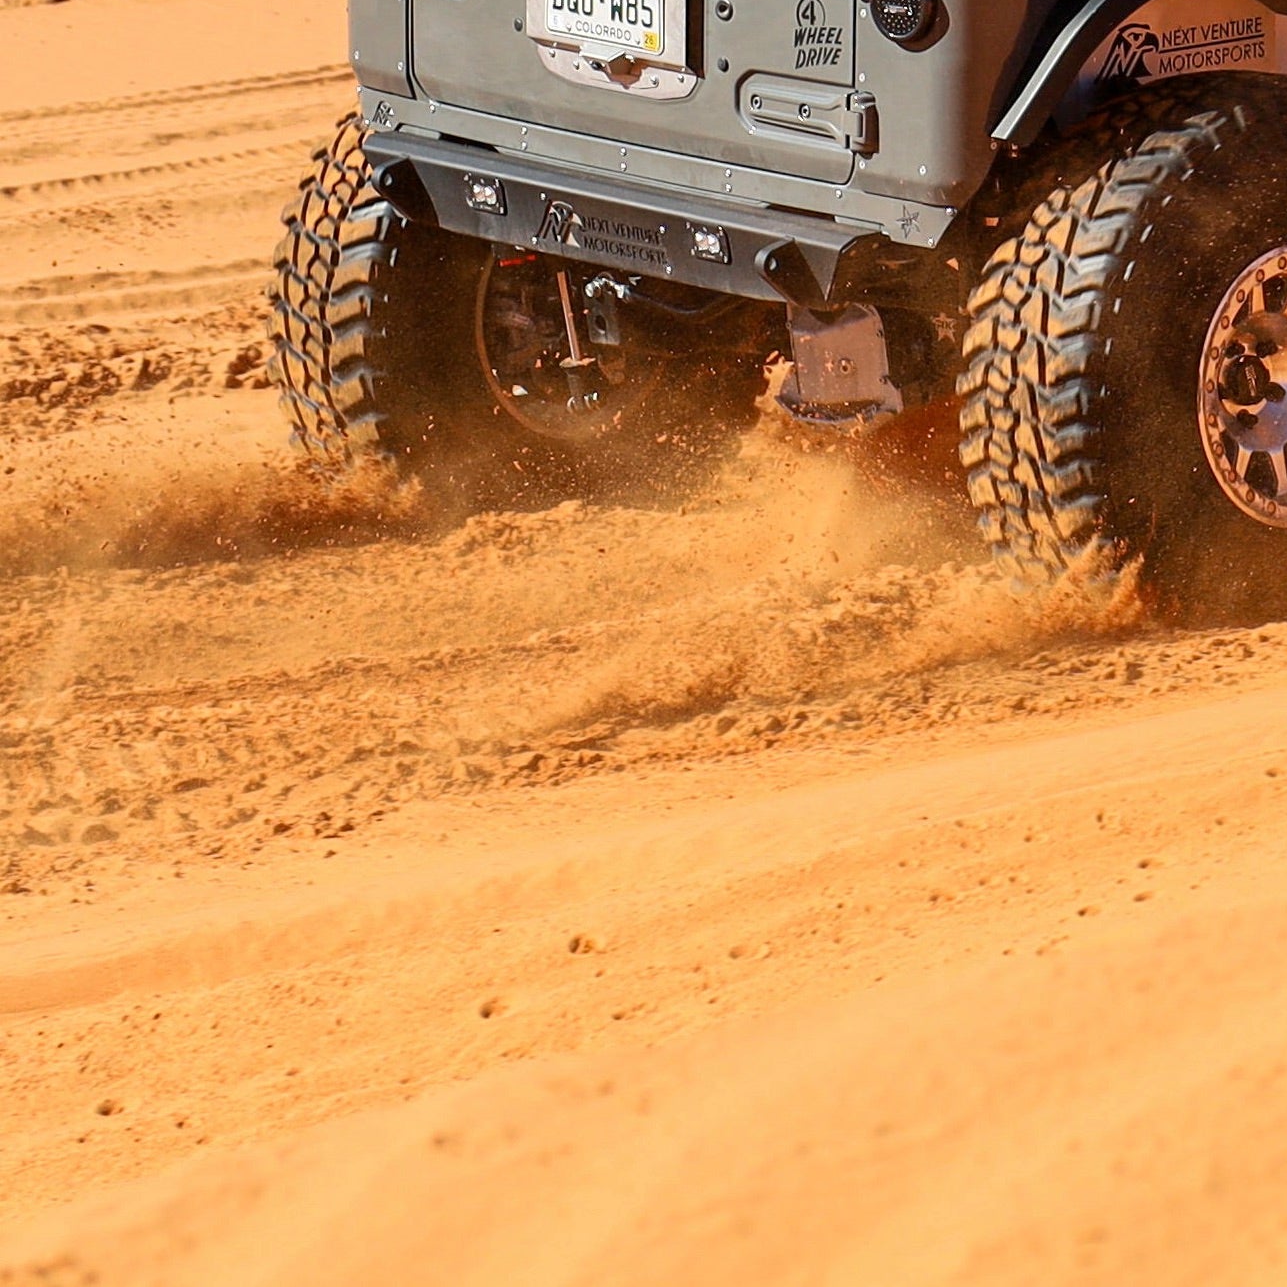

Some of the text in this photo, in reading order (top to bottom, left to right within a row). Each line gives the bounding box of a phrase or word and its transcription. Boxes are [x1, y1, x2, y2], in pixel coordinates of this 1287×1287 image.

[801, 0, 816, 26] 4
[575, 19, 632, 42] COLORADO
[794, 27, 843, 48] WHEEL
[1162, 16, 1263, 48] NEXT VENTURE
[795, 46, 842, 70] DRIVE
[1159, 41, 1265, 74] MOTORSPORTS
[582, 215, 609, 234] NEXT
